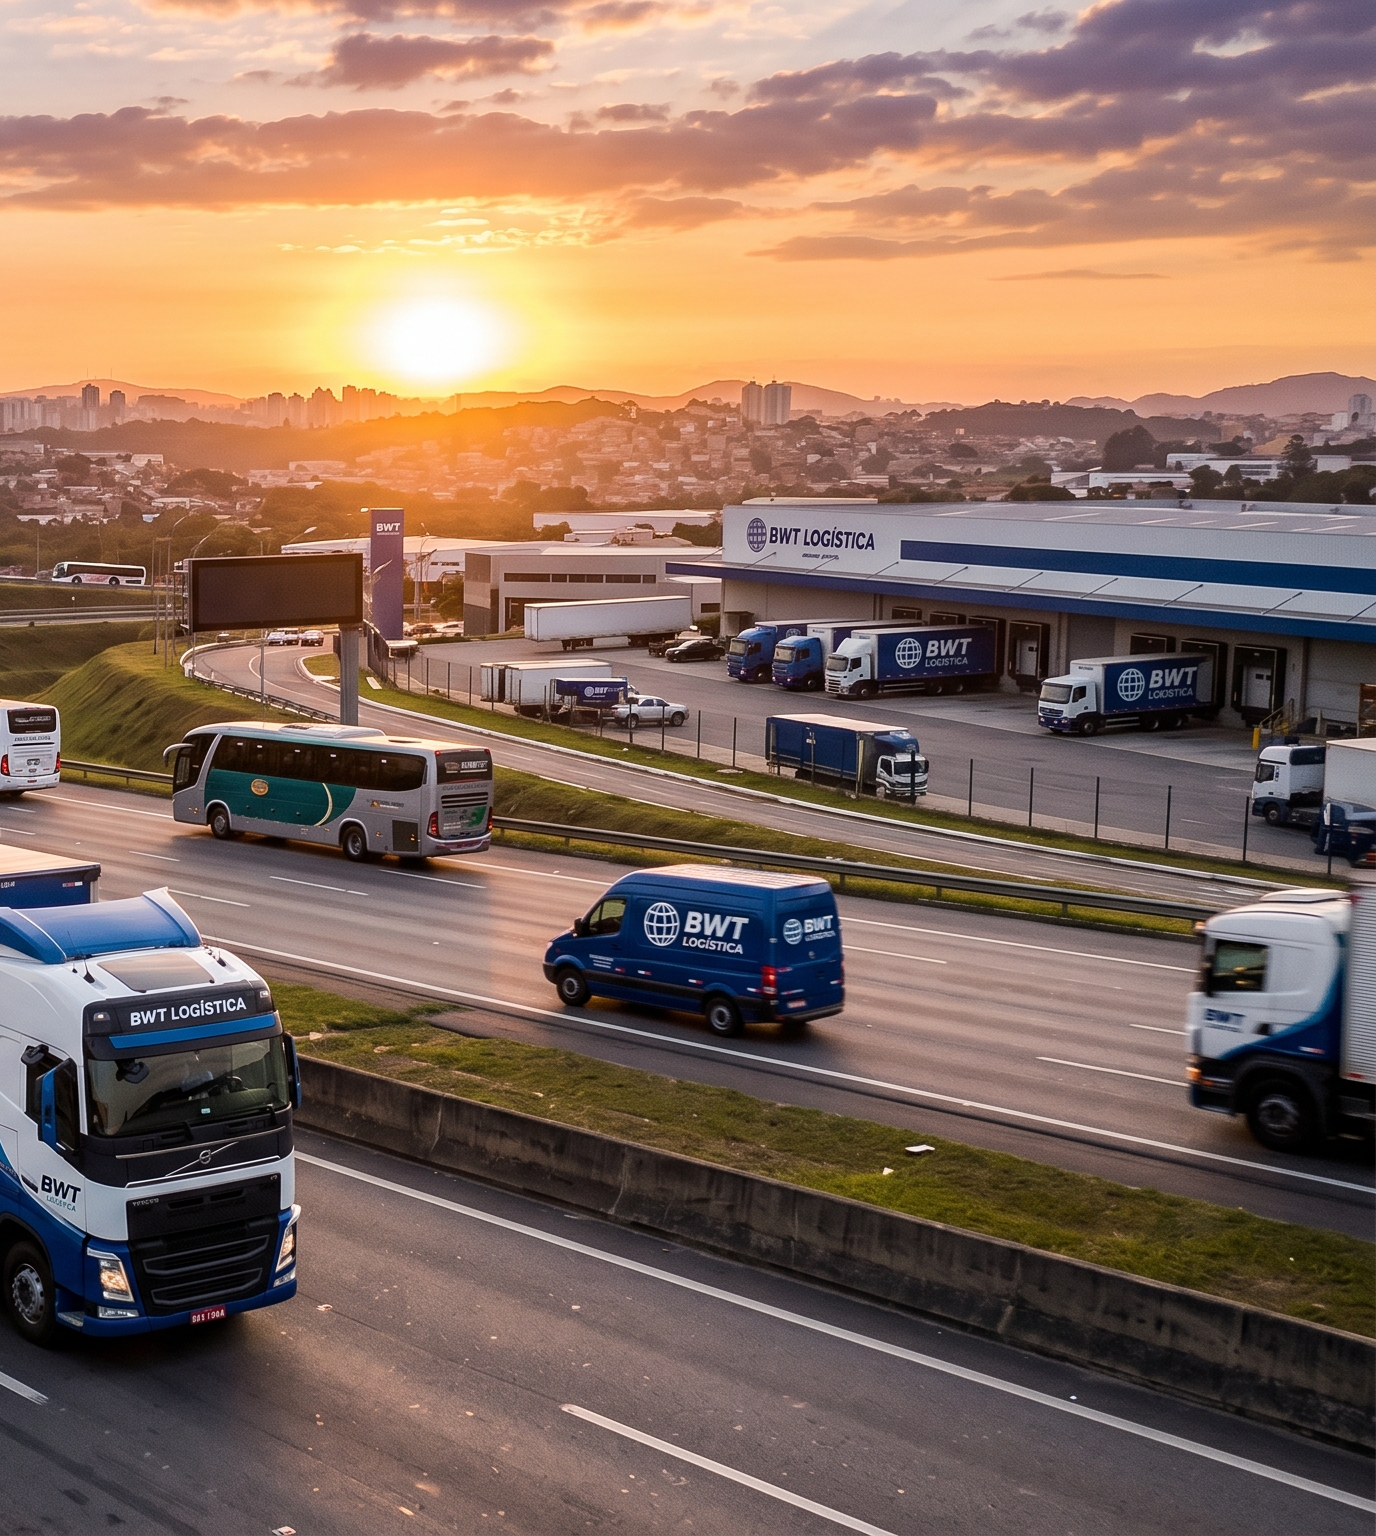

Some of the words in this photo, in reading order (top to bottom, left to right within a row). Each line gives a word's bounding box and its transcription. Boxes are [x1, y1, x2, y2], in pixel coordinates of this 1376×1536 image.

[376, 522, 401, 532] BWT
[769, 526, 801, 545] BWT
[803, 526, 875, 551] LOGÍSTICA
[925, 637, 972, 657] BWT
[1149, 666, 1197, 689] BWT
[684, 910, 749, 940] BWT
[804, 914, 834, 933] BWT
[130, 1008, 167, 1027] BWT
[171, 997, 247, 1020] LOGÍSTICA
[41, 1174, 81, 1204] BWT
